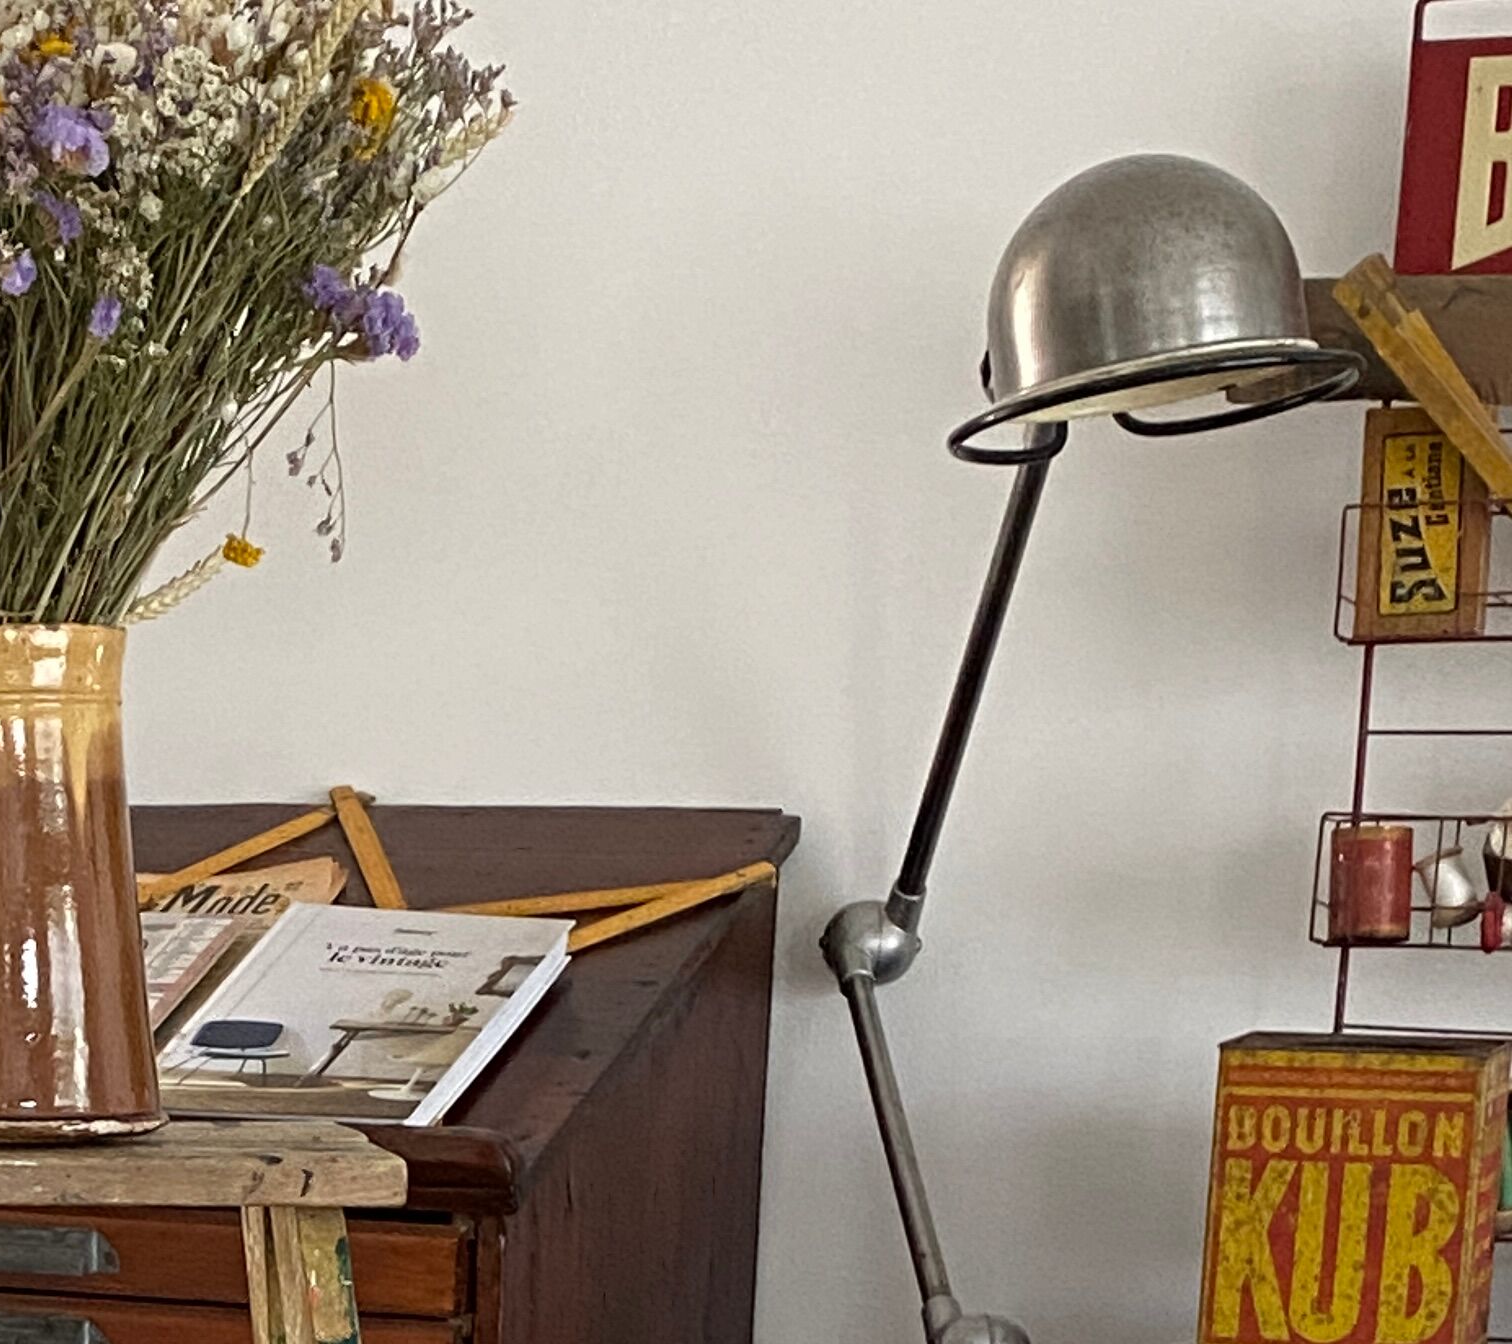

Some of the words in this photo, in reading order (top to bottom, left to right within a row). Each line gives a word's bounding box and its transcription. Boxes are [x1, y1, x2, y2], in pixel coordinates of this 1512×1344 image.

[1387, 486, 1448, 604] SUZE
[1226, 1103, 1465, 1158] BOUILLON
[1212, 1158, 1461, 1344] KUB
